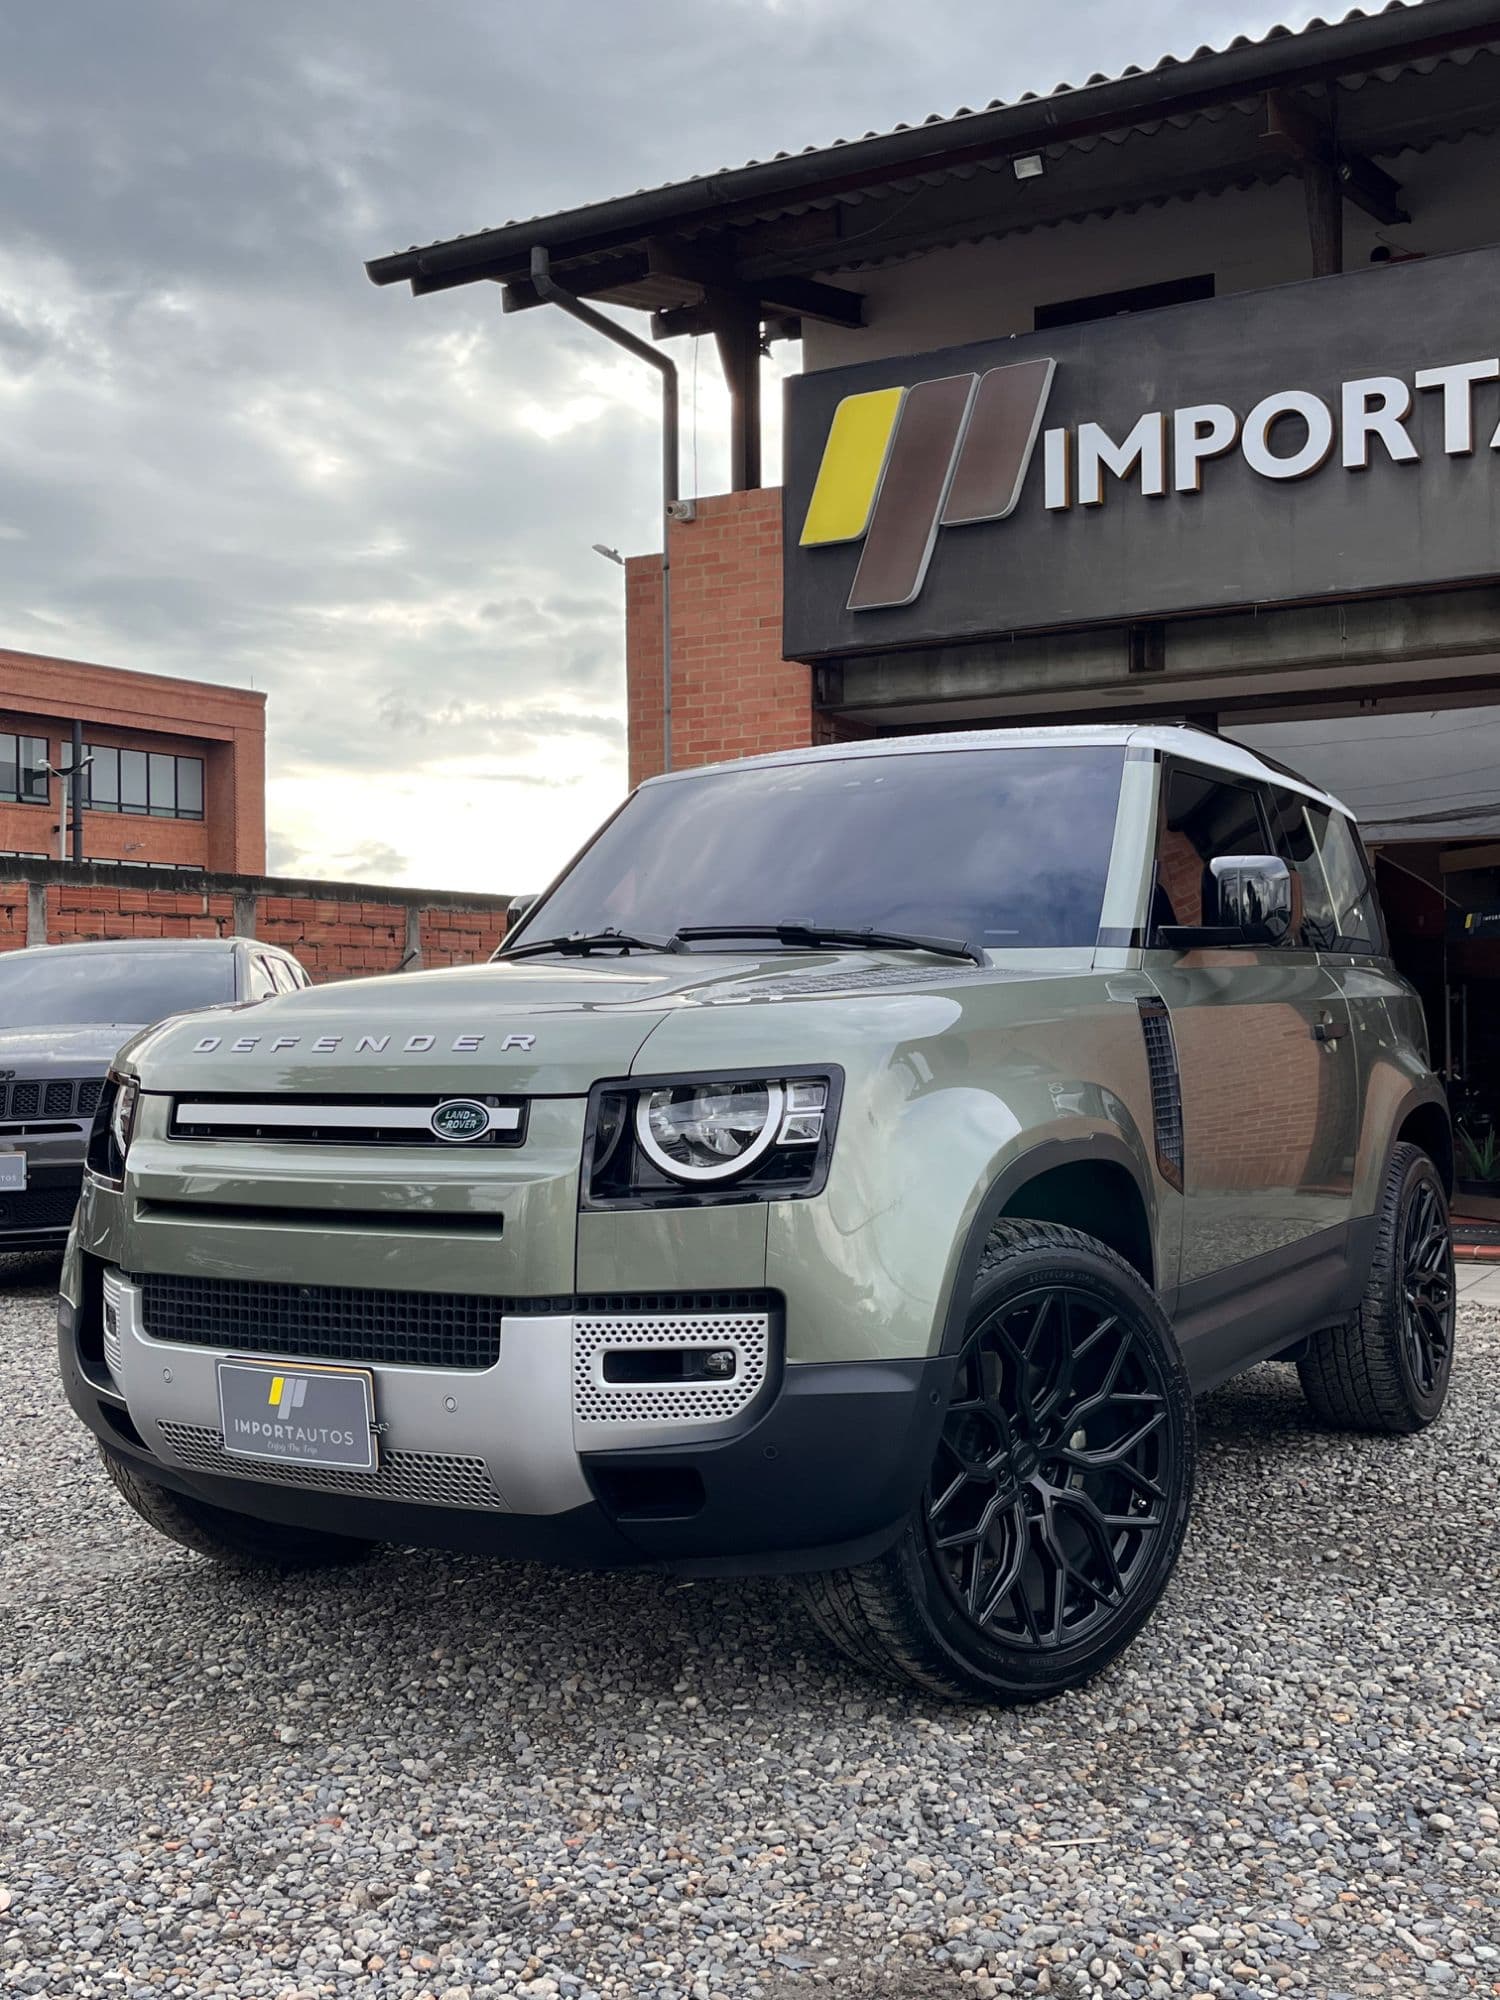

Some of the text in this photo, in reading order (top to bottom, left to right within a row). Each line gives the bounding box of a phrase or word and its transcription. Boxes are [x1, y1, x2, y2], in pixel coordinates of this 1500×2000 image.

[1044, 358, 1500, 511] IMPORT
[192, 1033, 536, 1053] DEFENDER
[234, 1418, 354, 1446] IMPORTAUTOS
